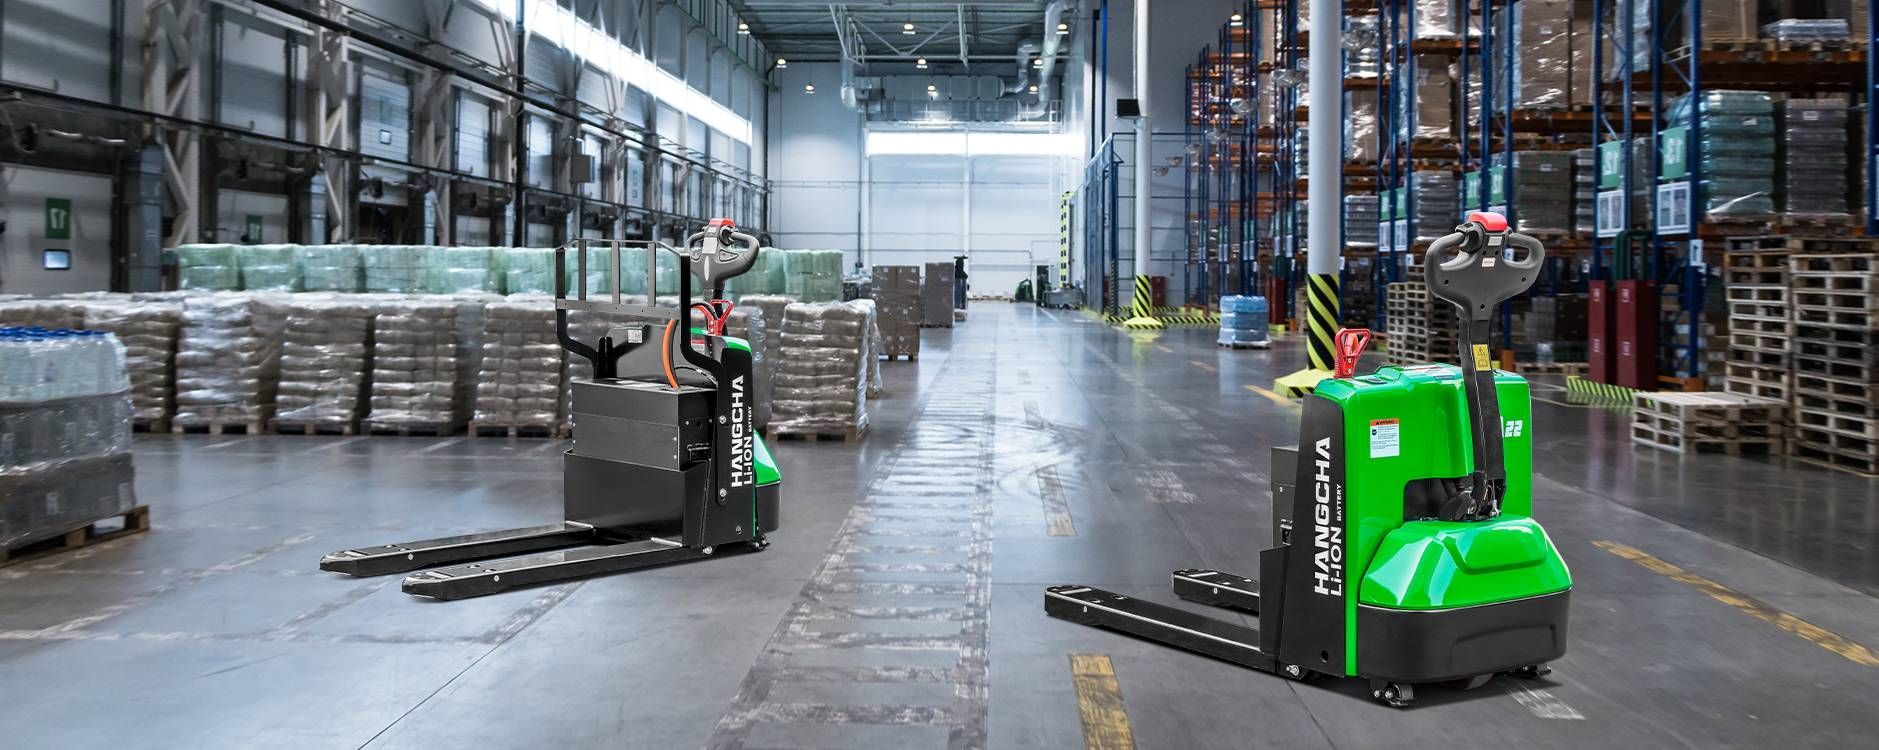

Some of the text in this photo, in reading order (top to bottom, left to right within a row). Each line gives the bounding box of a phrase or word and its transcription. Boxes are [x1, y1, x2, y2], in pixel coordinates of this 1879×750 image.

[731, 375, 744, 487] HANGCHA
[743, 436, 753, 485] Li-ION
[1504, 420, 1523, 437] 22
[1314, 437, 1330, 595] HANGCHA
[1330, 526, 1342, 596] Li-ION
